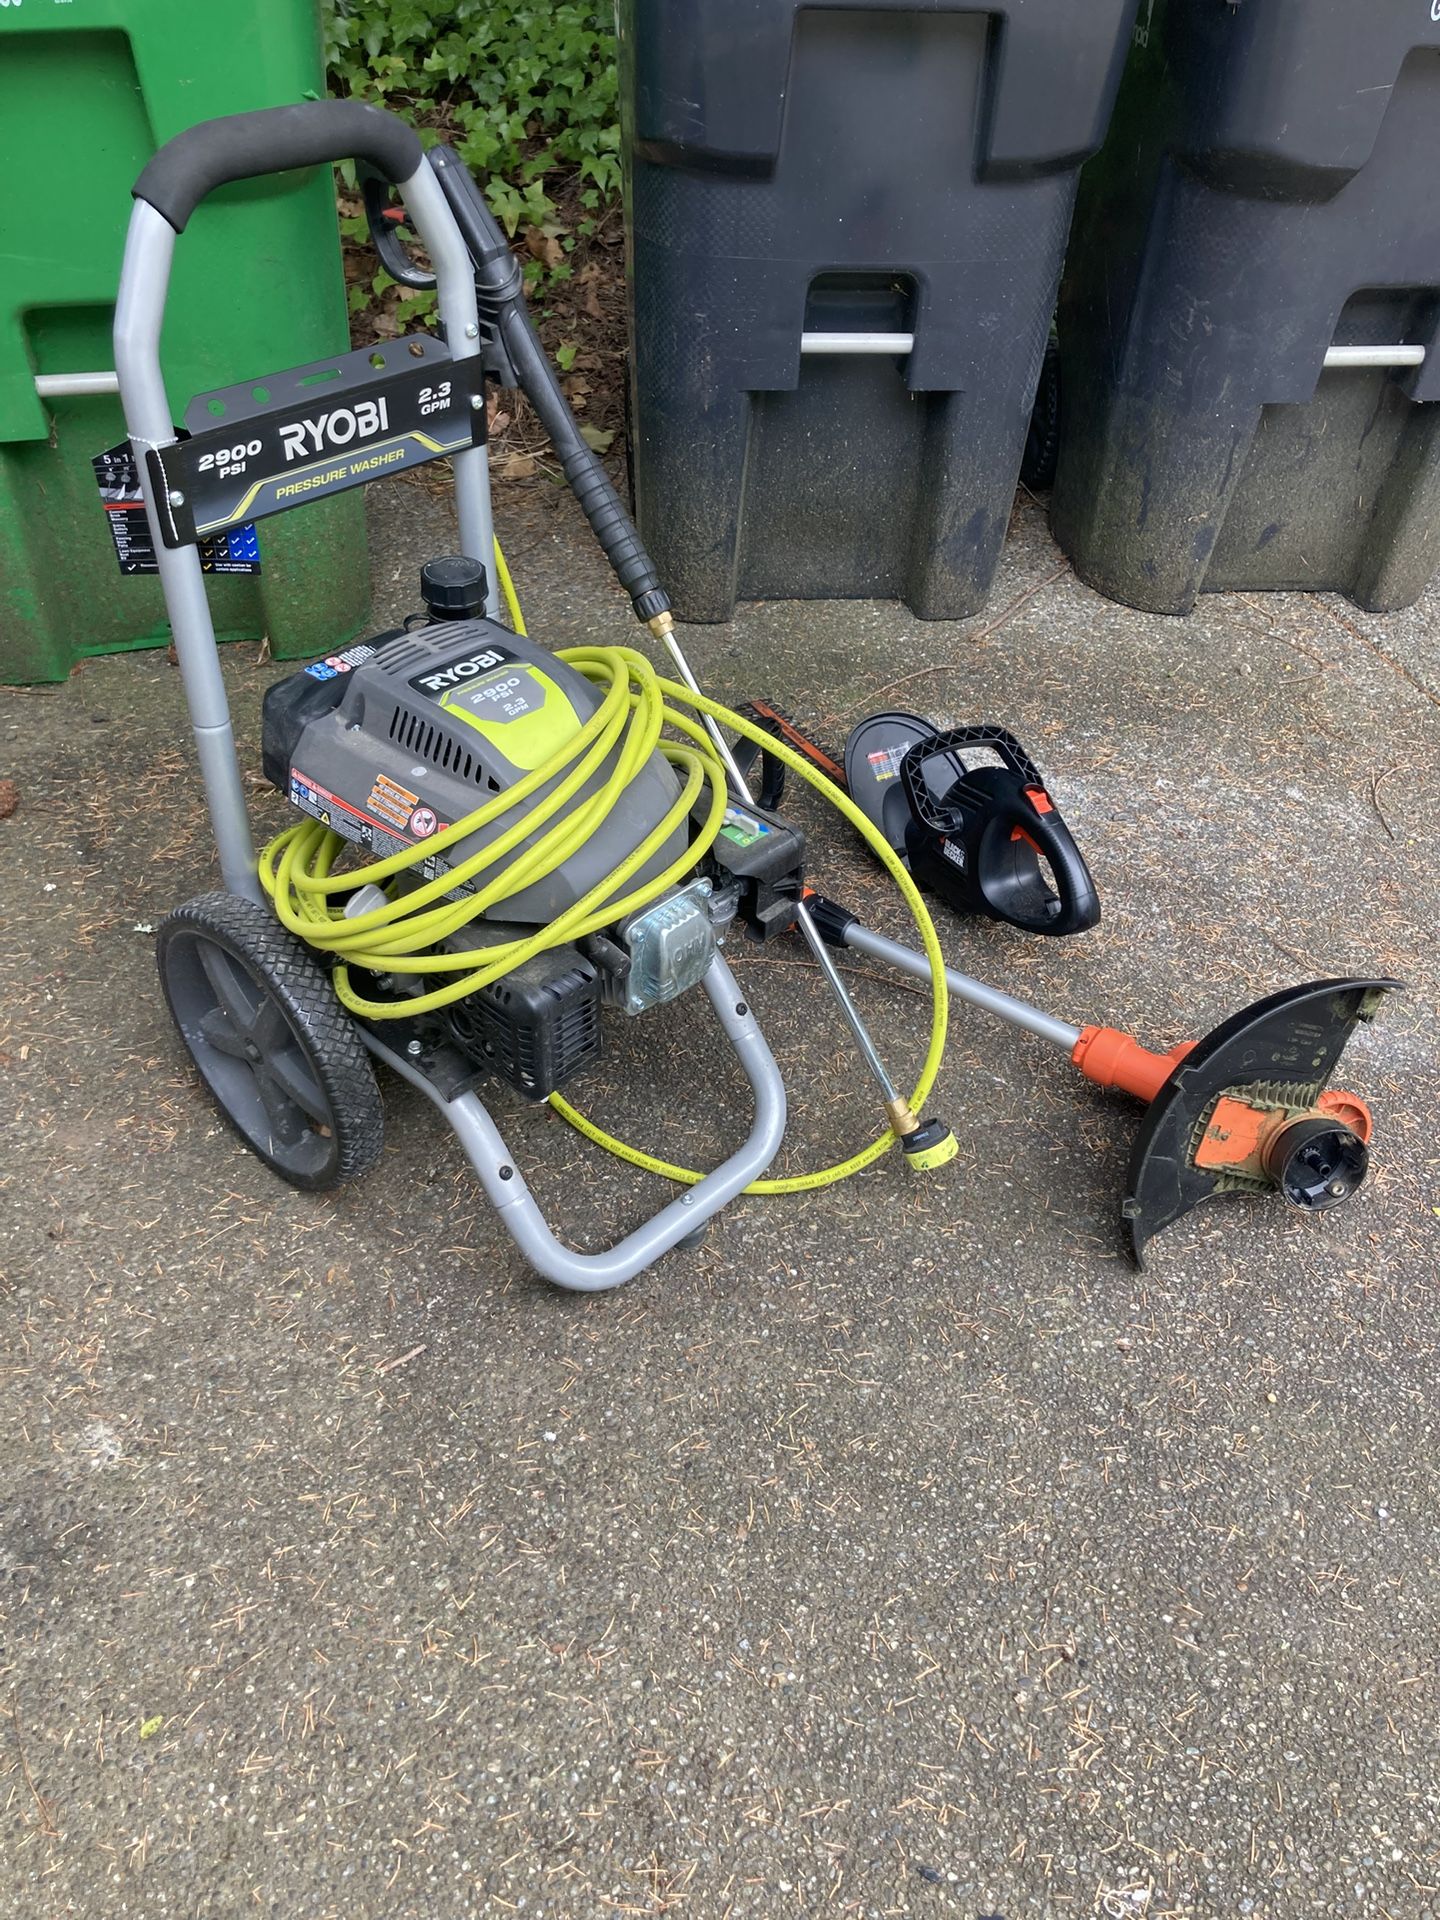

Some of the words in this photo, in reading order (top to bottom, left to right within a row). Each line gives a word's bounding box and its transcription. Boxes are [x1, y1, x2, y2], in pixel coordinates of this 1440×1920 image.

[418, 381, 452, 404] 2.3
[420, 397, 451, 416] GPM
[278, 396, 390, 461] RYOBI
[103, 454, 112, 465] 5
[124, 453, 130, 463] 1
[198, 439, 263, 472] 2900
[219, 460, 246, 480] PSI
[275, 467, 348, 500] PRESSURE
[349, 448, 405, 476] WASHER
[418, 650, 505, 691] RYOBI
[470, 677, 521, 704] 2900
[491, 689, 514, 702] PSI
[503, 697, 526, 712] 2.3
[508, 702, 529, 716] GPM
[943, 846, 965, 869] DECKER
[944, 838, 962, 856] BLACK
[674, 931, 705, 962] OHV
